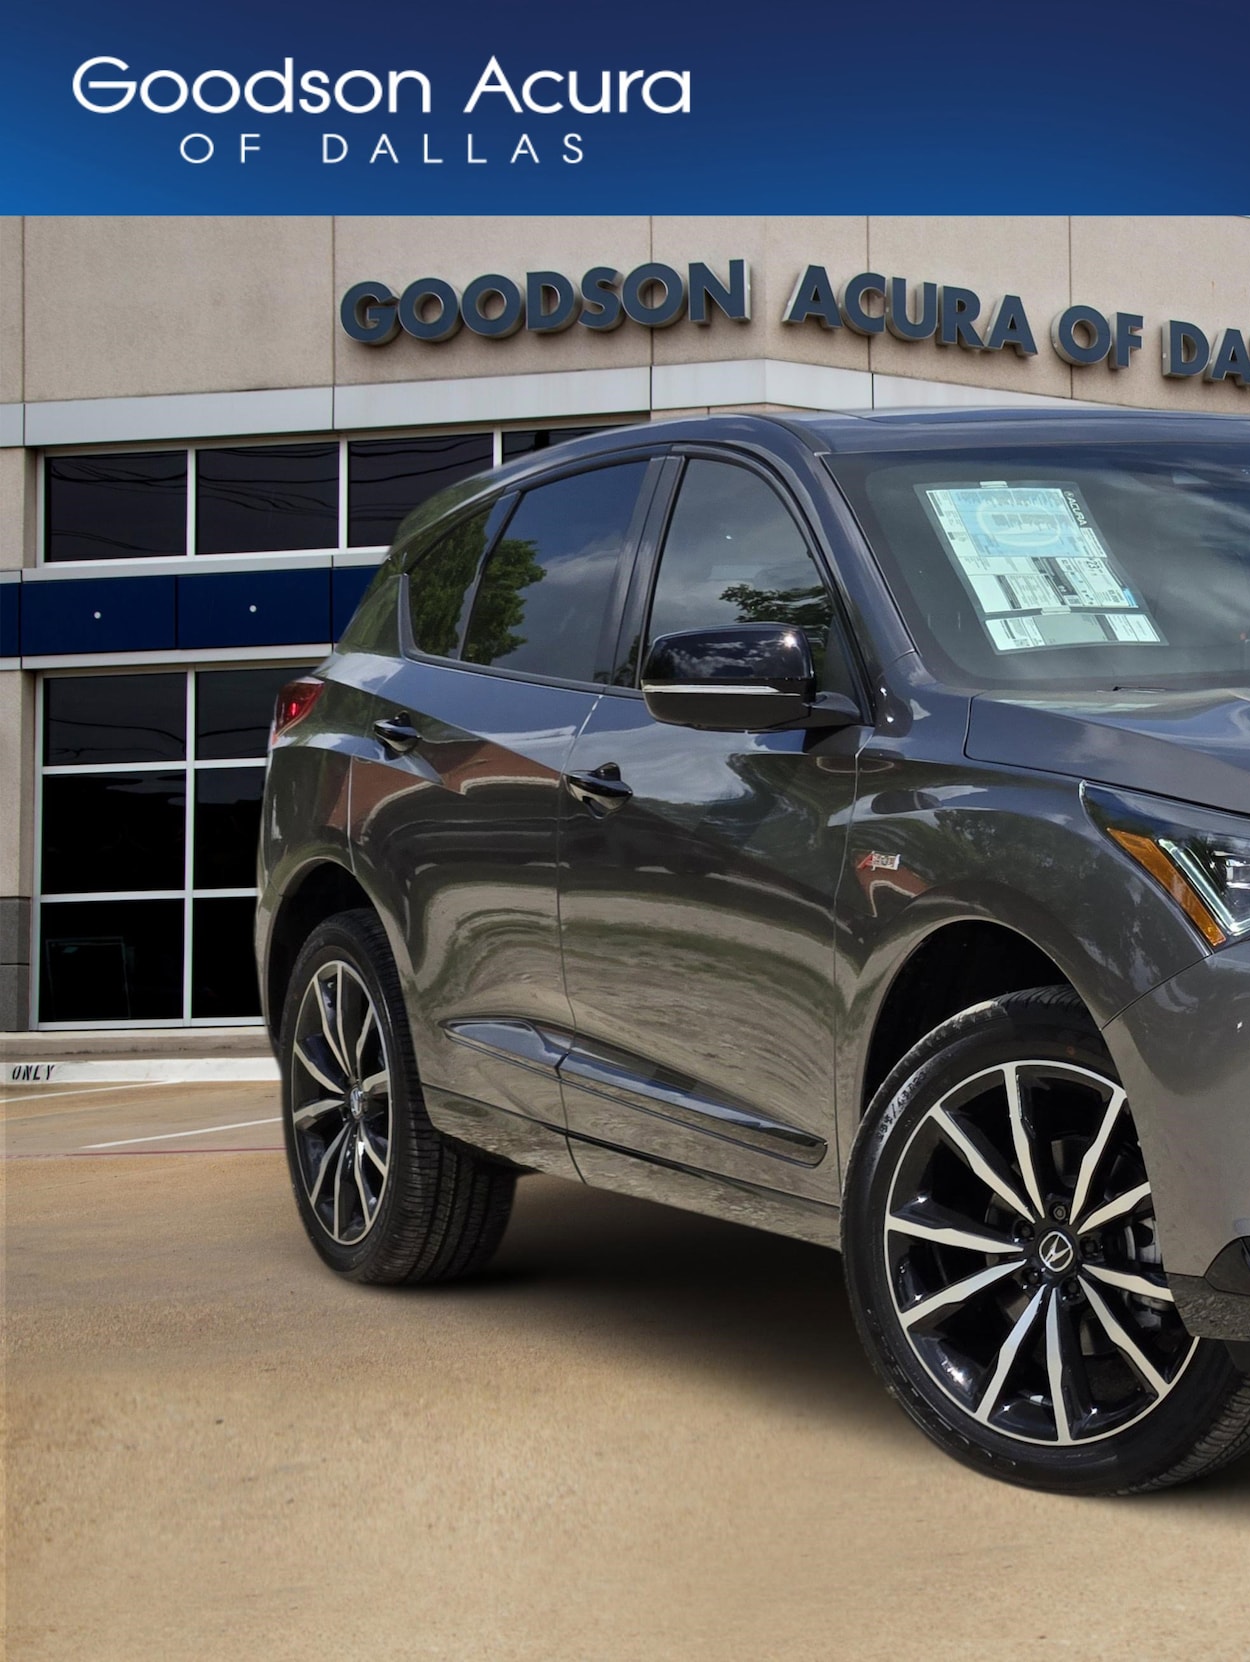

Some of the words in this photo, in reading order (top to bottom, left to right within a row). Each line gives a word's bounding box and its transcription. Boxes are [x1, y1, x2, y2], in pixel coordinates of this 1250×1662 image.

[340, 259, 752, 347] GOODSON
[783, 264, 1038, 358] ACURA
[1051, 304, 1144, 368] OF
[1067, 496, 1088, 526] ACURA
[12, 1064, 55, 1081] ONLY
